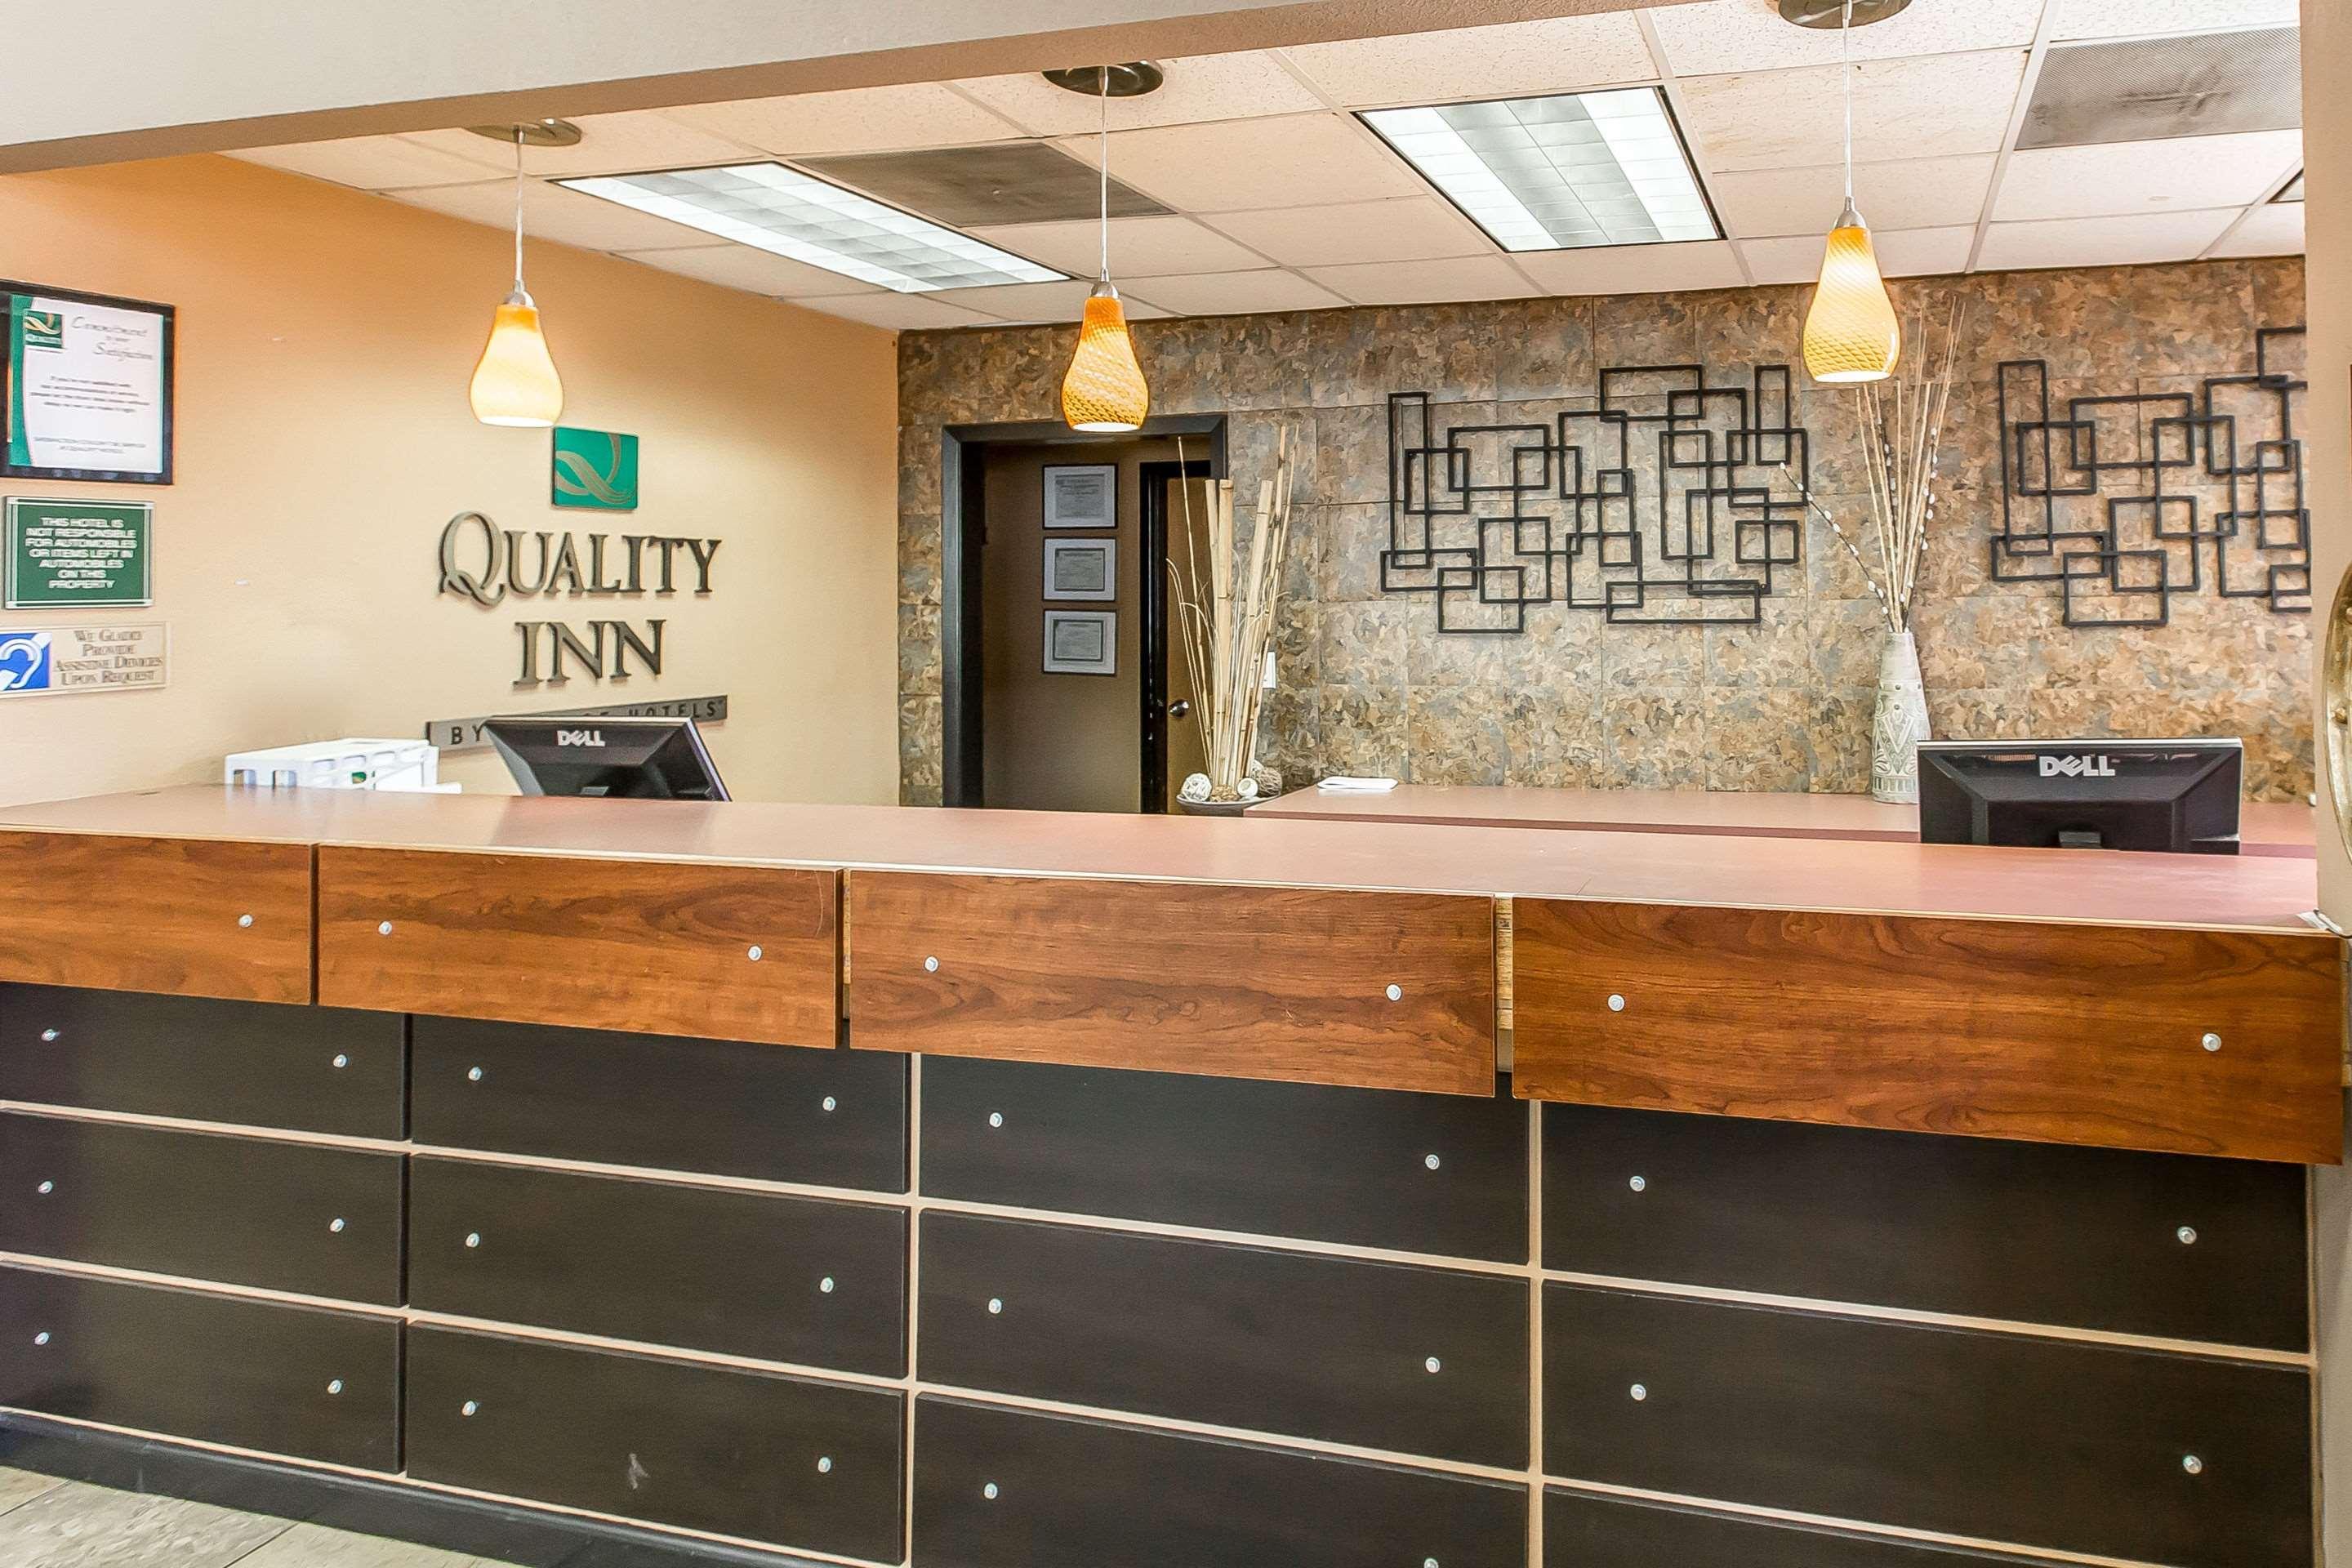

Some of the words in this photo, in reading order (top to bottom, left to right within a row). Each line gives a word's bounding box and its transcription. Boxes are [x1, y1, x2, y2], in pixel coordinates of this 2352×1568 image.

[40, 517, 69, 527] THIS
[70, 519, 110, 528] HOTEL
[111, 519, 124, 528] IS
[25, 528, 53, 537] NOT
[55, 528, 136, 538] RESPONSIBLE
[24, 538, 53, 547] FOR
[54, 539, 137, 549] AUTOMOBILES
[89, 550, 119, 558] LEFT
[439, 510, 723, 607] QUALITY
[38, 559, 124, 569] AUTOMOBILES
[512, 619, 667, 686] INN
[450, 724, 484, 745] BY
[556, 729, 606, 747] DELL
[2039, 754, 2116, 777] DELL
